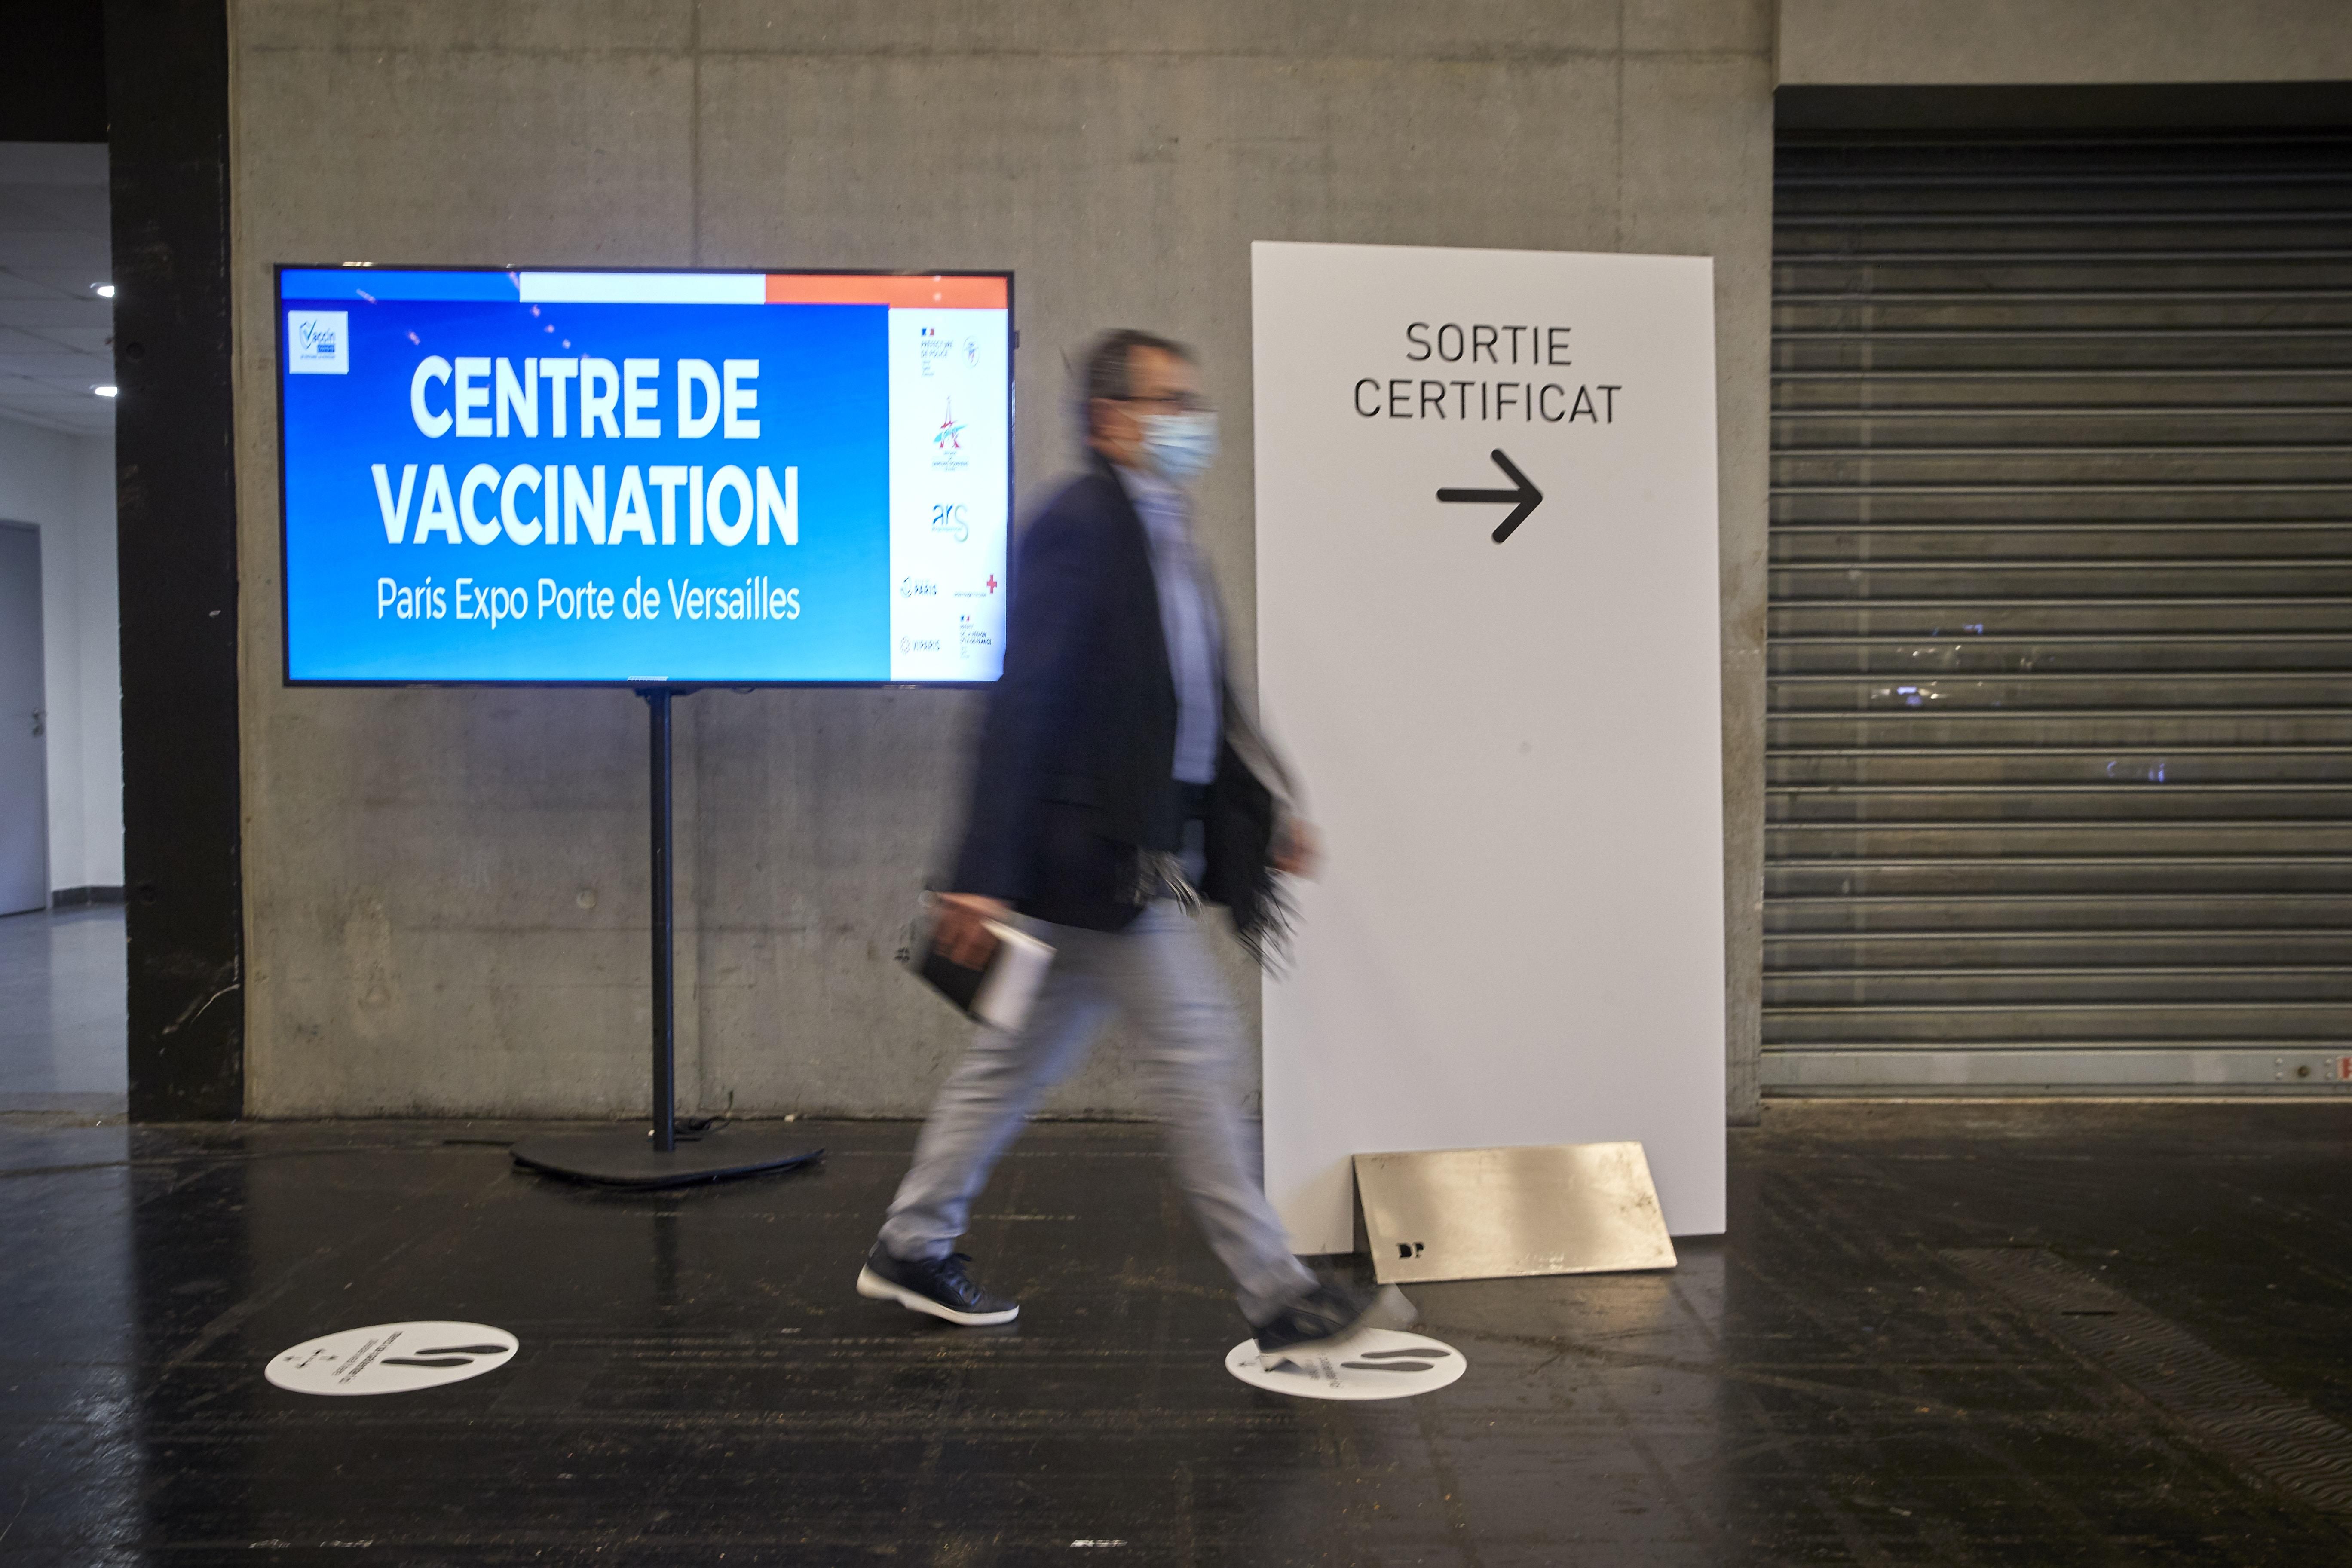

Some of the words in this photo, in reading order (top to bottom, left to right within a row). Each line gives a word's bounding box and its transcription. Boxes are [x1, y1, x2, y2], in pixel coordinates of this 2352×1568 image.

[1406, 322, 1572, 366] SORTIE
[410, 355, 661, 438] CENTRE
[677, 358, 760, 439] DE
[1354, 377, 1623, 424] CERTIFICAT
[371, 463, 799, 547] VACCINATION
[932, 504, 968, 542] ars
[378, 576, 447, 619] Paris
[456, 578, 528, 630] Expo
[538, 578, 615, 620] Porte
[622, 576, 661, 620] de
[668, 576, 801, 620] Versailles
